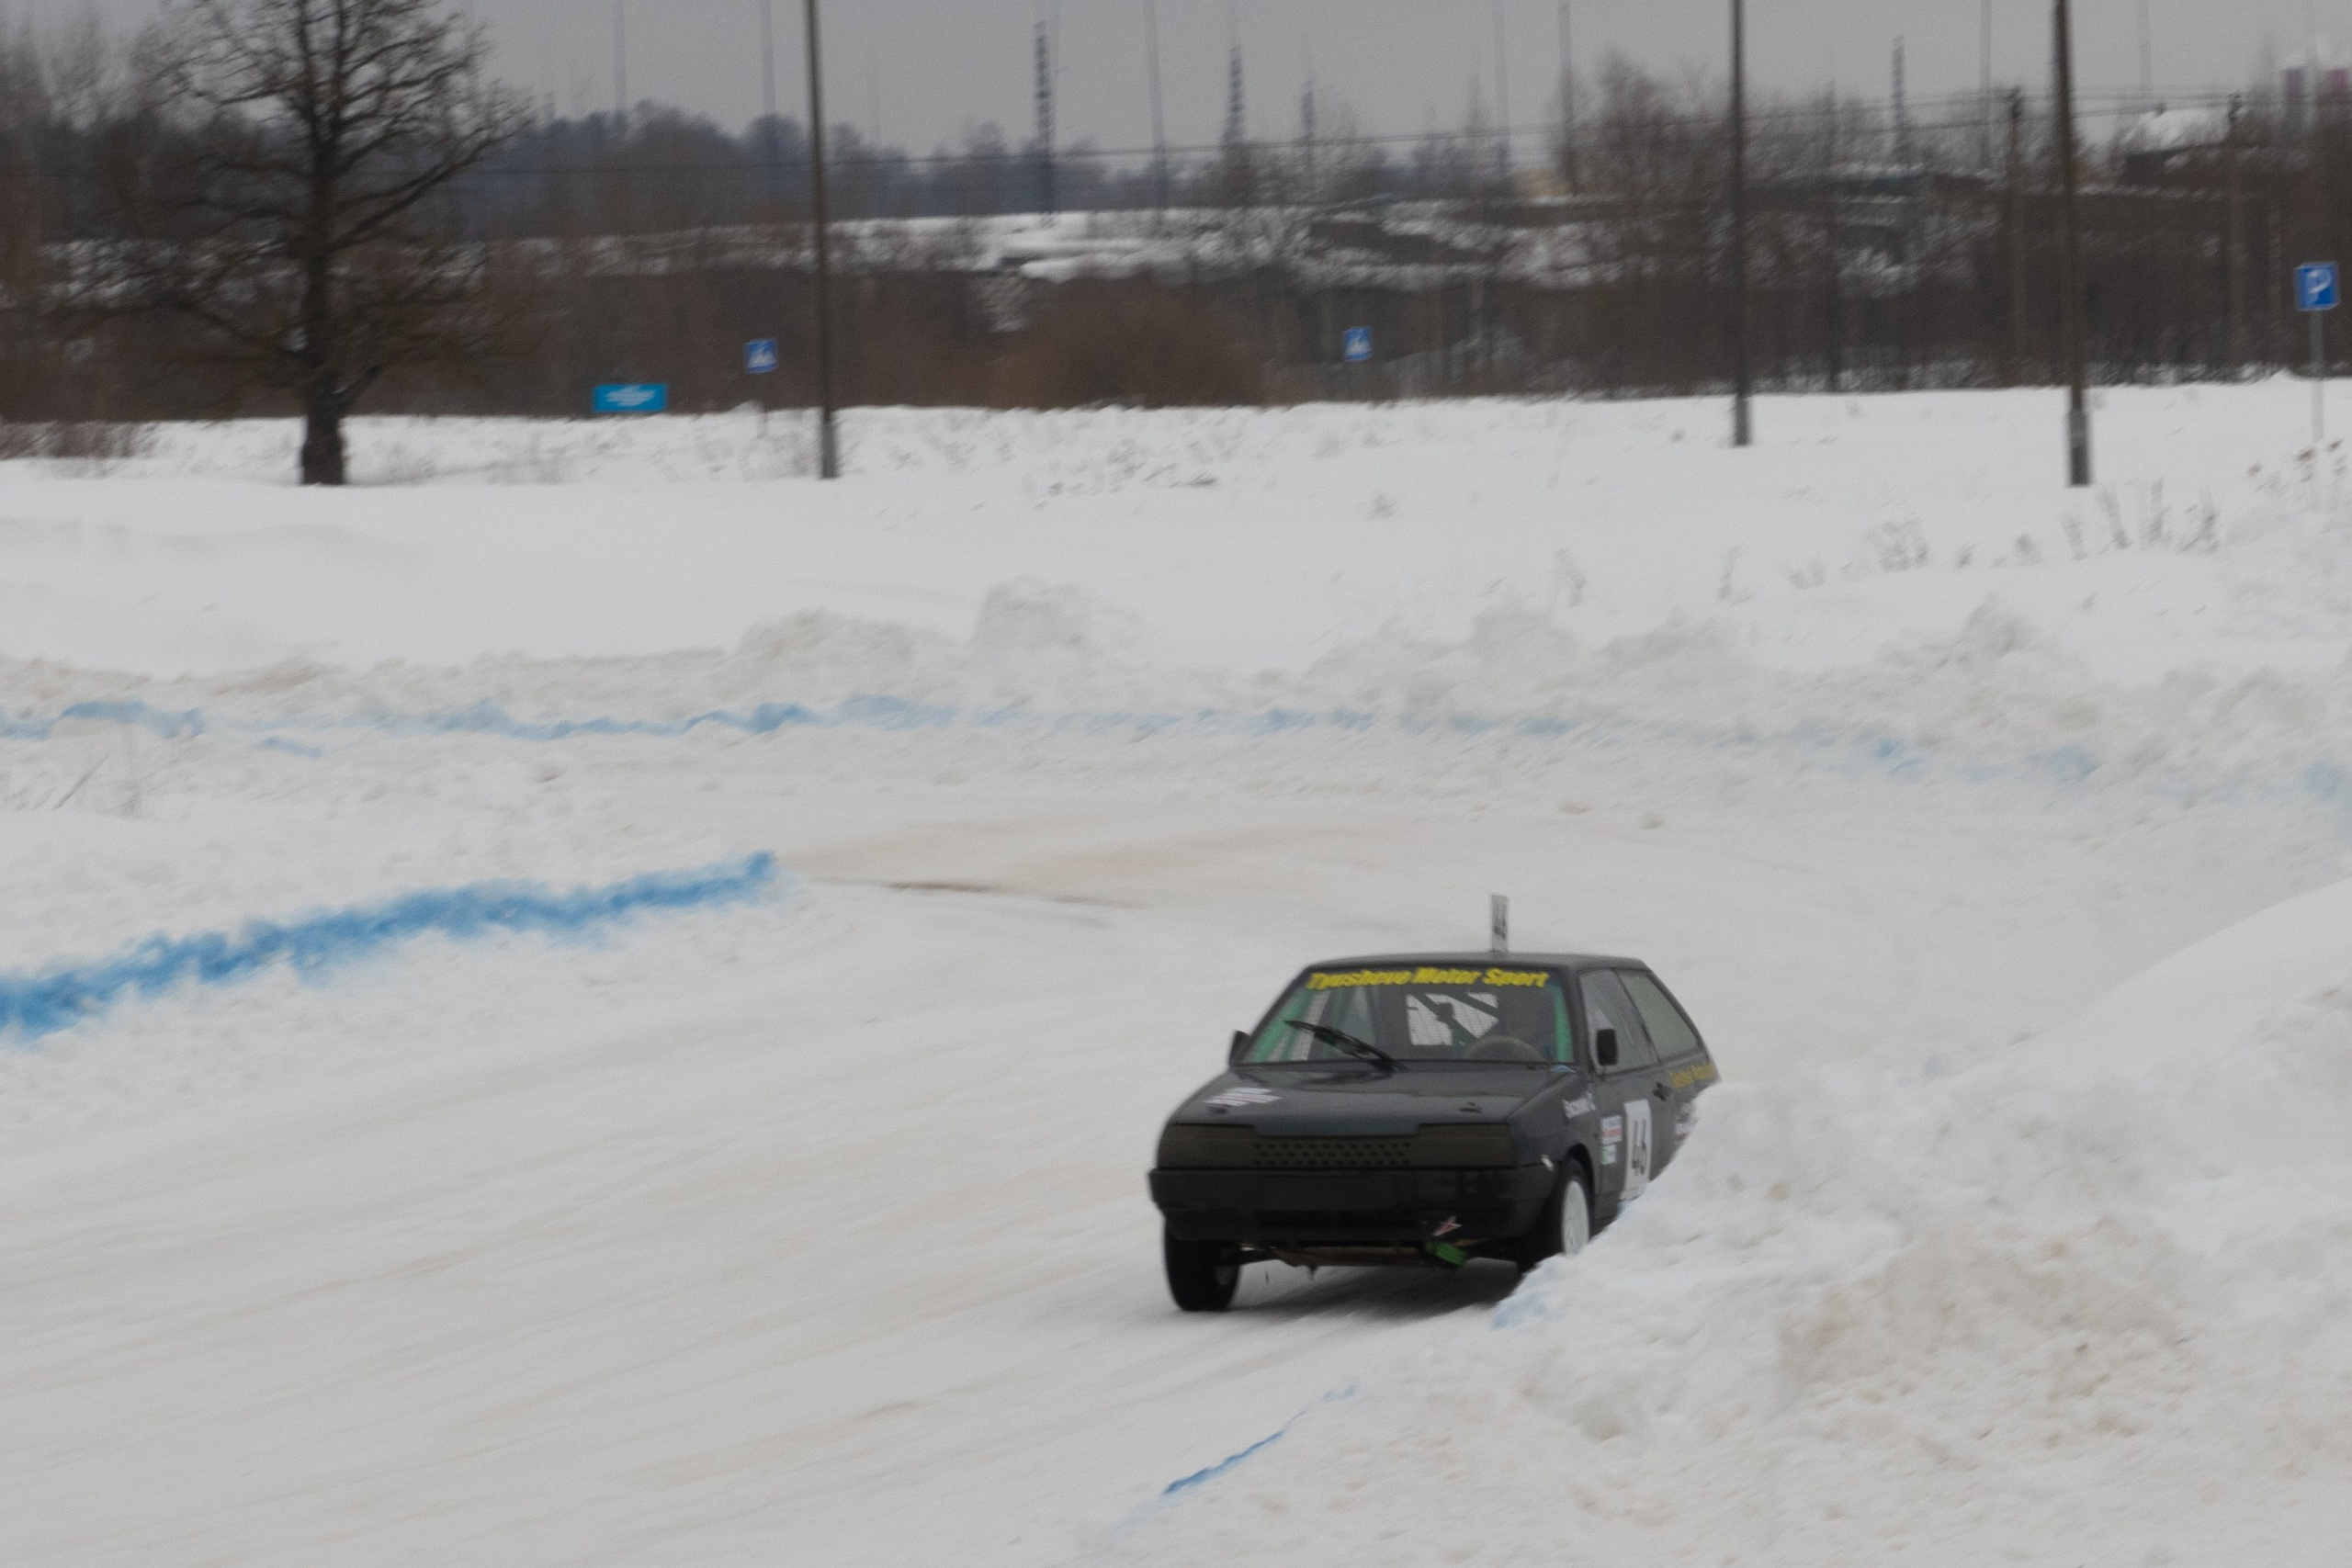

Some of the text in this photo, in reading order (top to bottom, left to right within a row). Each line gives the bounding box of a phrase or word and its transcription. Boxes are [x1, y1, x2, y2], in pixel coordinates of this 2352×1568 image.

[2307, 269, 2331, 303] P
[1411, 967, 1482, 985] Motor
[1482, 967, 1550, 987] Sport
